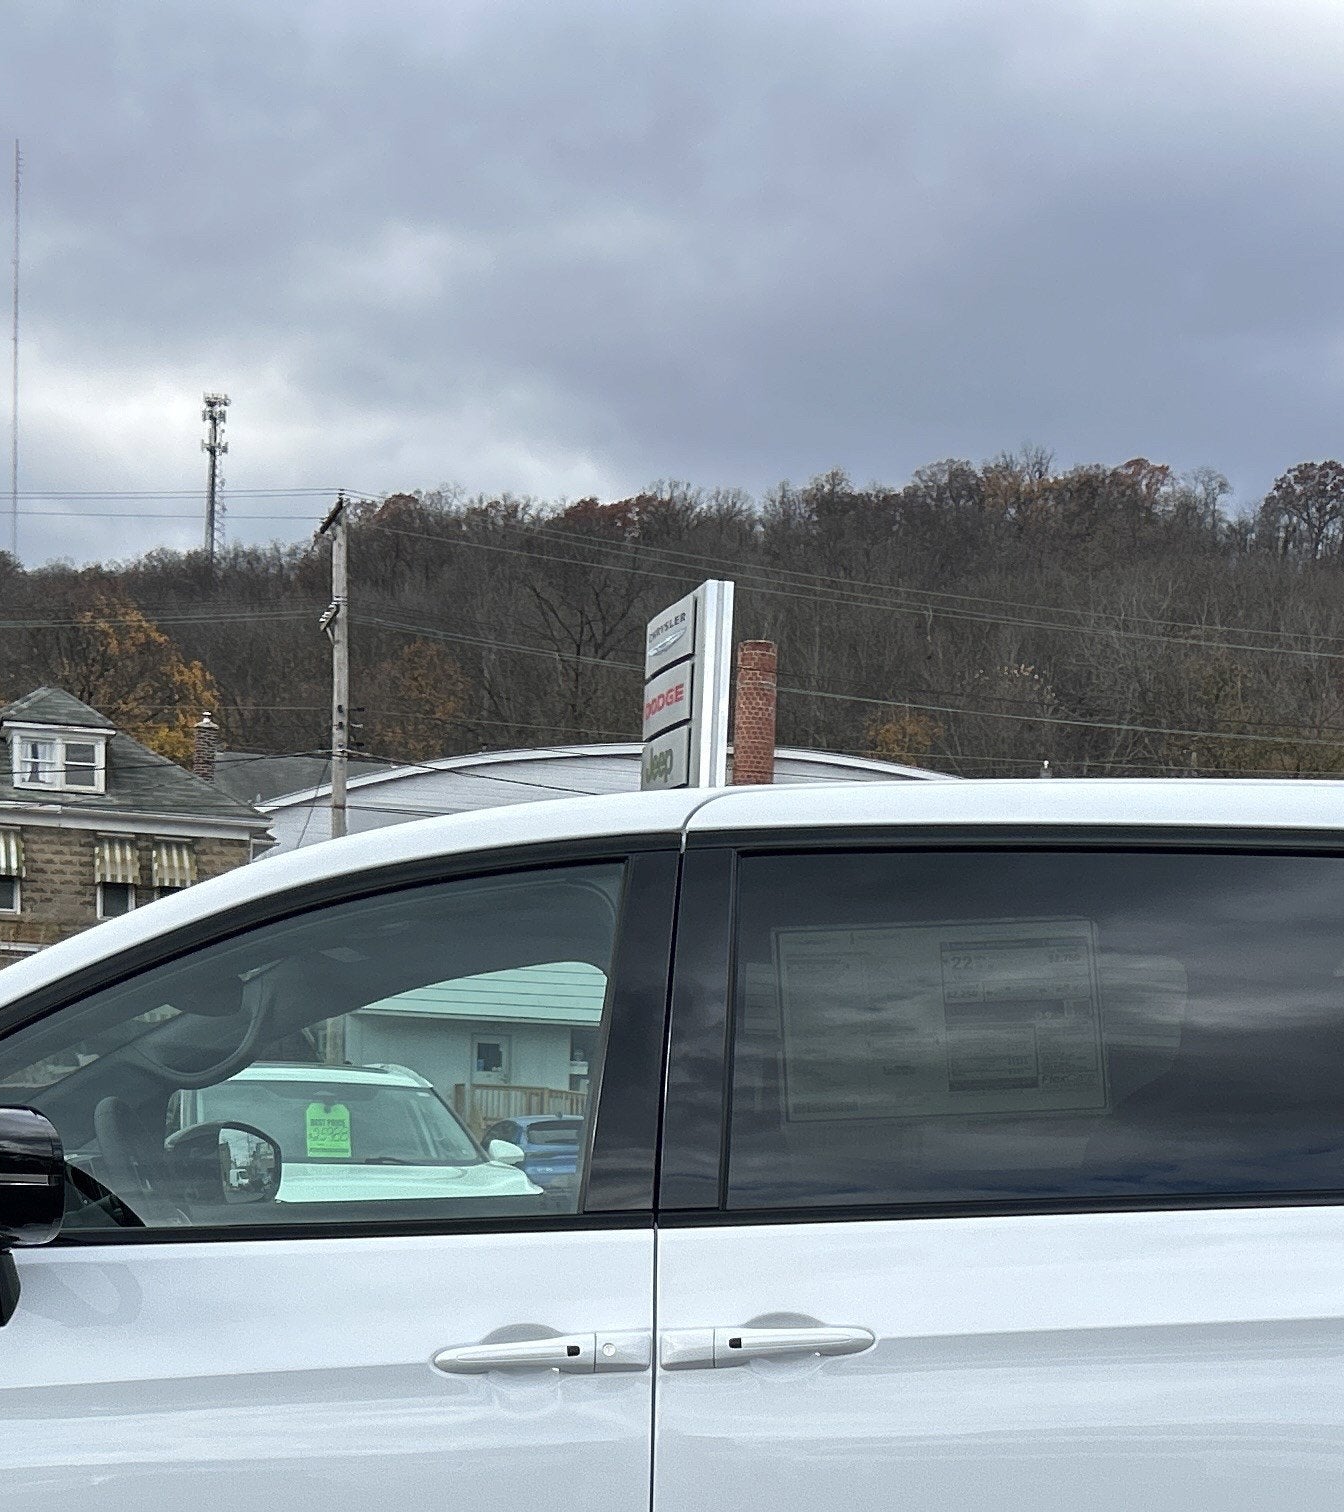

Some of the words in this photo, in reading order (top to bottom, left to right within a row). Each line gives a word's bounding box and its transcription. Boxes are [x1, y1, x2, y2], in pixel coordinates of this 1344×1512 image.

[649, 611, 687, 643] CHRYSLER
[644, 683, 684, 721] DODGE
[645, 747, 674, 783] Jeep
